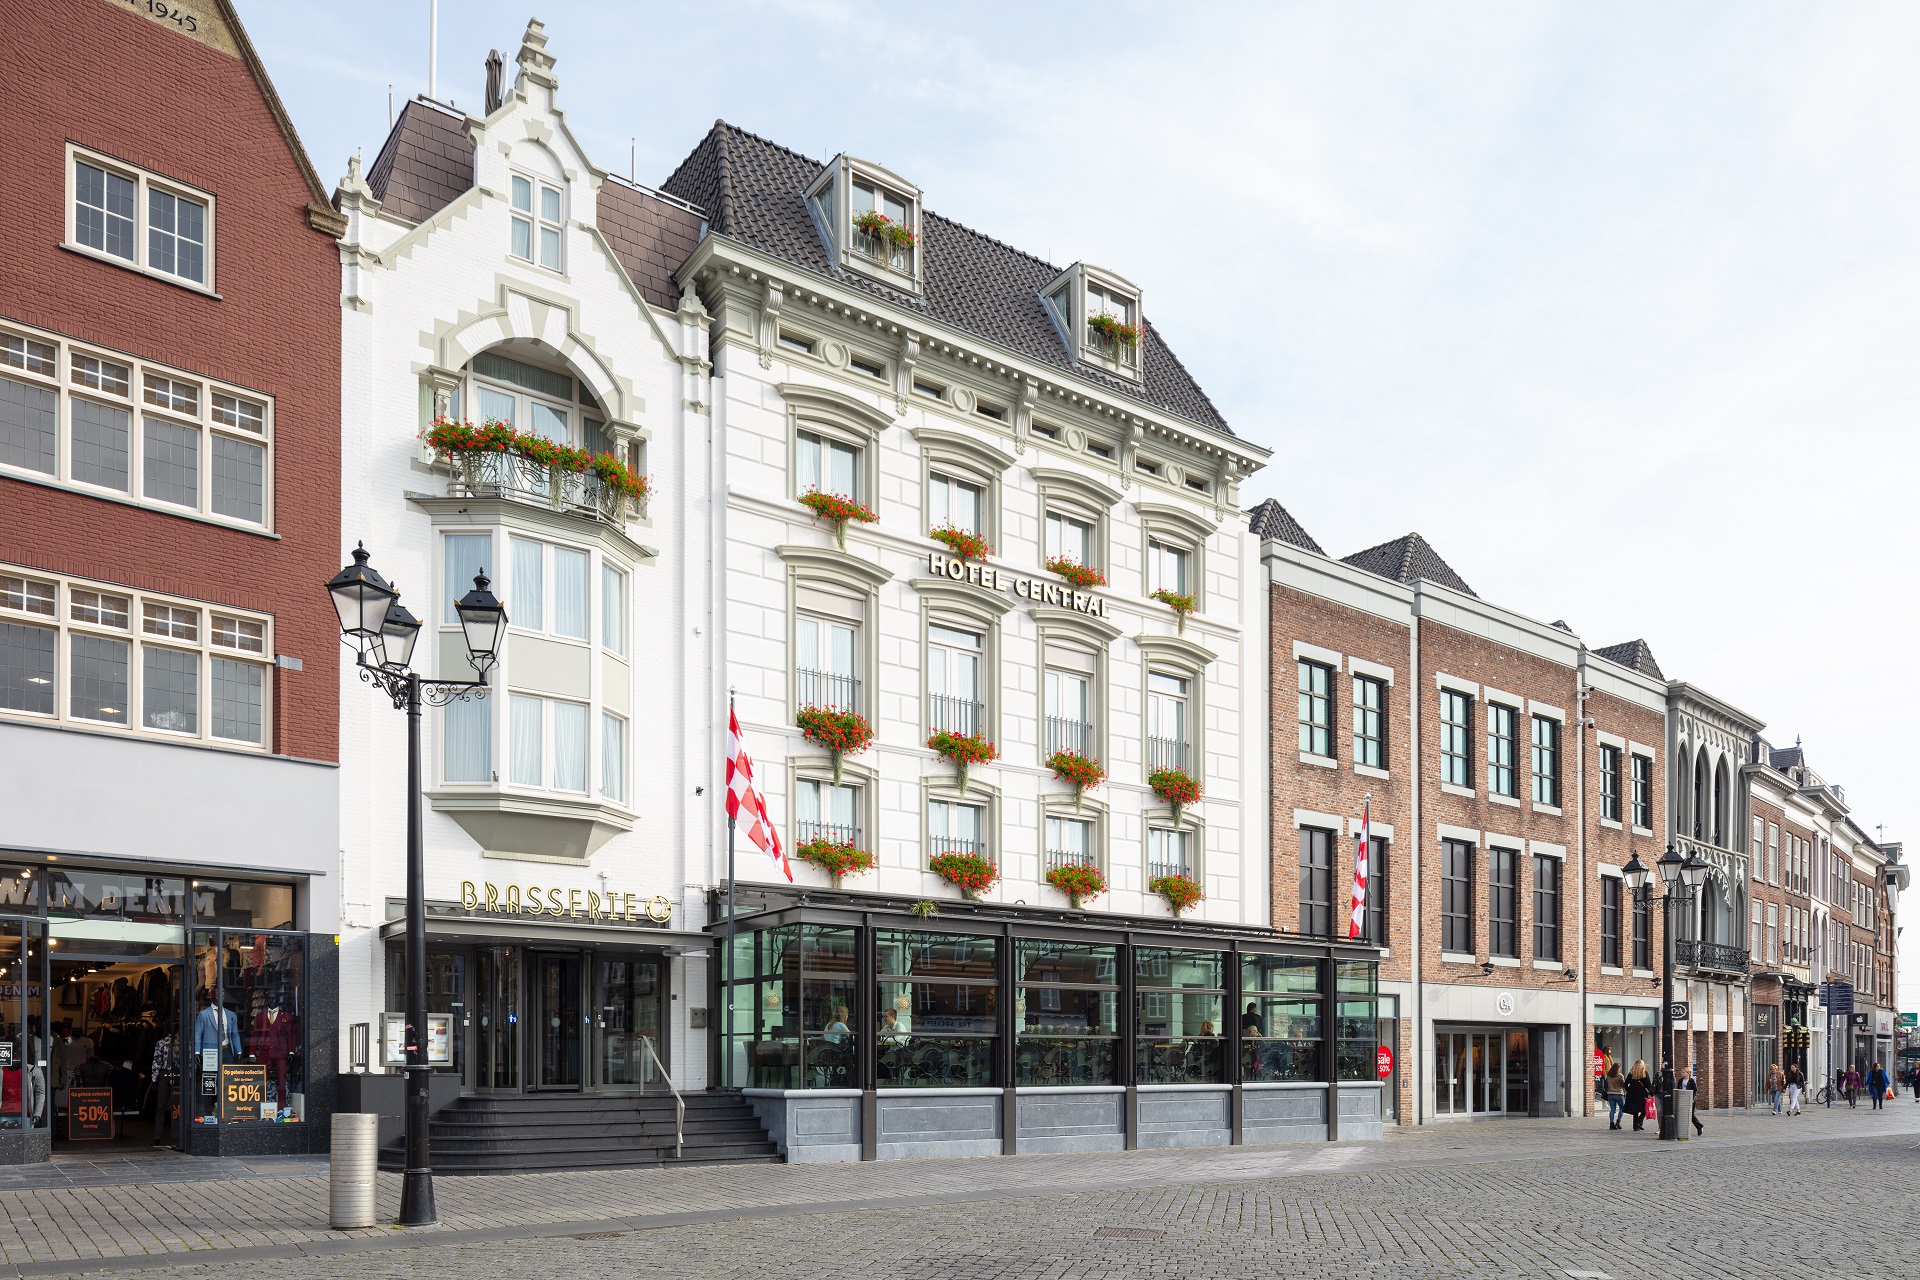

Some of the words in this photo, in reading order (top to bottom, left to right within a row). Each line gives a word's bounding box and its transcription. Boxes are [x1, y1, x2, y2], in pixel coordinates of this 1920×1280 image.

[146, 0, 197, 32] 1945
[928, 552, 1007, 592] HOTEL
[1013, 576, 1112, 620] CENTRAL
[101, 885, 216, 917] DENIM
[460, 879, 637, 922] BRASSERIE
[1378, 1053, 1391, 1065] sale
[228, 1084, 261, 1102] 50%
[73, 1106, 109, 1121] -50%
